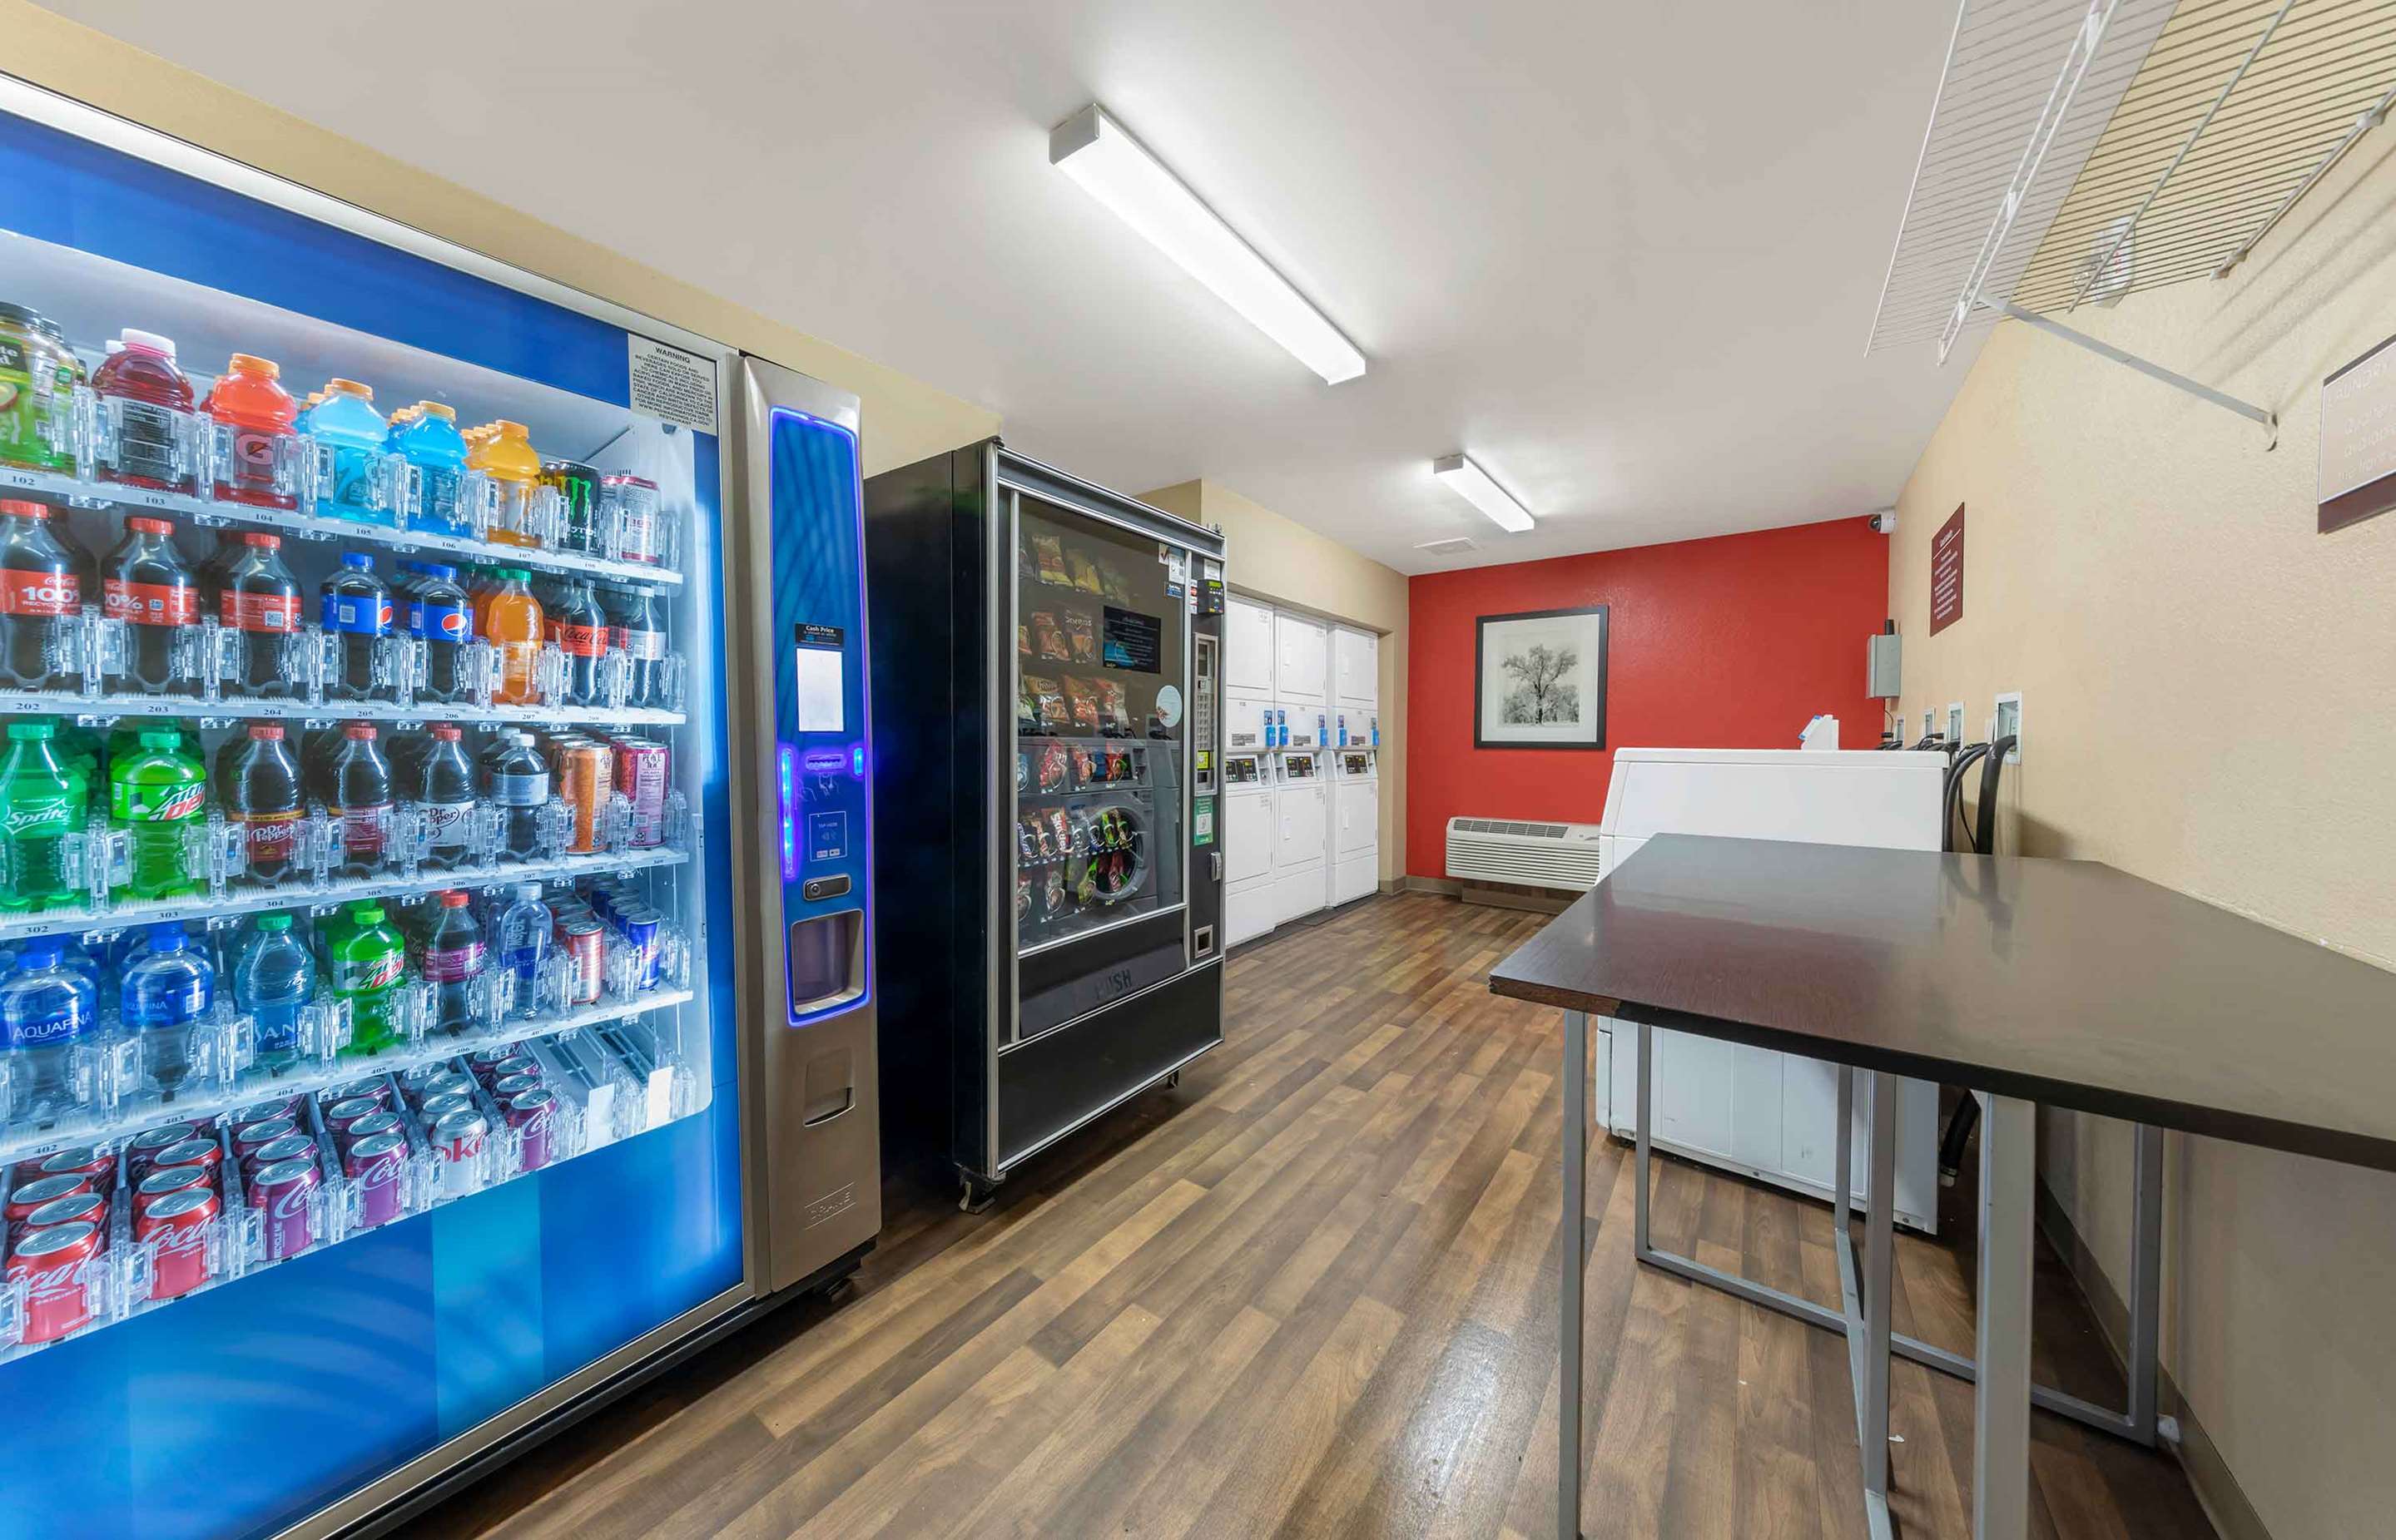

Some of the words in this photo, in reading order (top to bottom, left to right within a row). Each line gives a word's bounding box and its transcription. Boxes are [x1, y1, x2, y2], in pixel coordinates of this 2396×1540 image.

[656, 347, 690, 363] WARNING
[12, 476, 35, 486] 102
[146, 497, 166, 505] 103
[255, 513, 274, 522] 104
[355, 527, 371, 536] 105
[442, 541, 456, 549] 106
[16, 702, 40, 711] 202
[147, 705, 169, 714] 203
[263, 708, 282, 716] 204
[357, 710, 374, 718] 205
[444, 712, 459, 720] 206
[7, 808, 69, 826] Sprite
[429, 808, 447, 818] Dr
[265, 899, 284, 908] 304
[158, 911, 179, 919] 303
[25, 925, 49, 934] 302
[12, 1010, 93, 1040] AQUAFNA
[455, 1046, 470, 1054] 406
[371, 1066, 388, 1075] 405
[275, 1087, 295, 1097] 404
[165, 1115, 185, 1124] 403
[34, 1143, 57, 1155] 402
